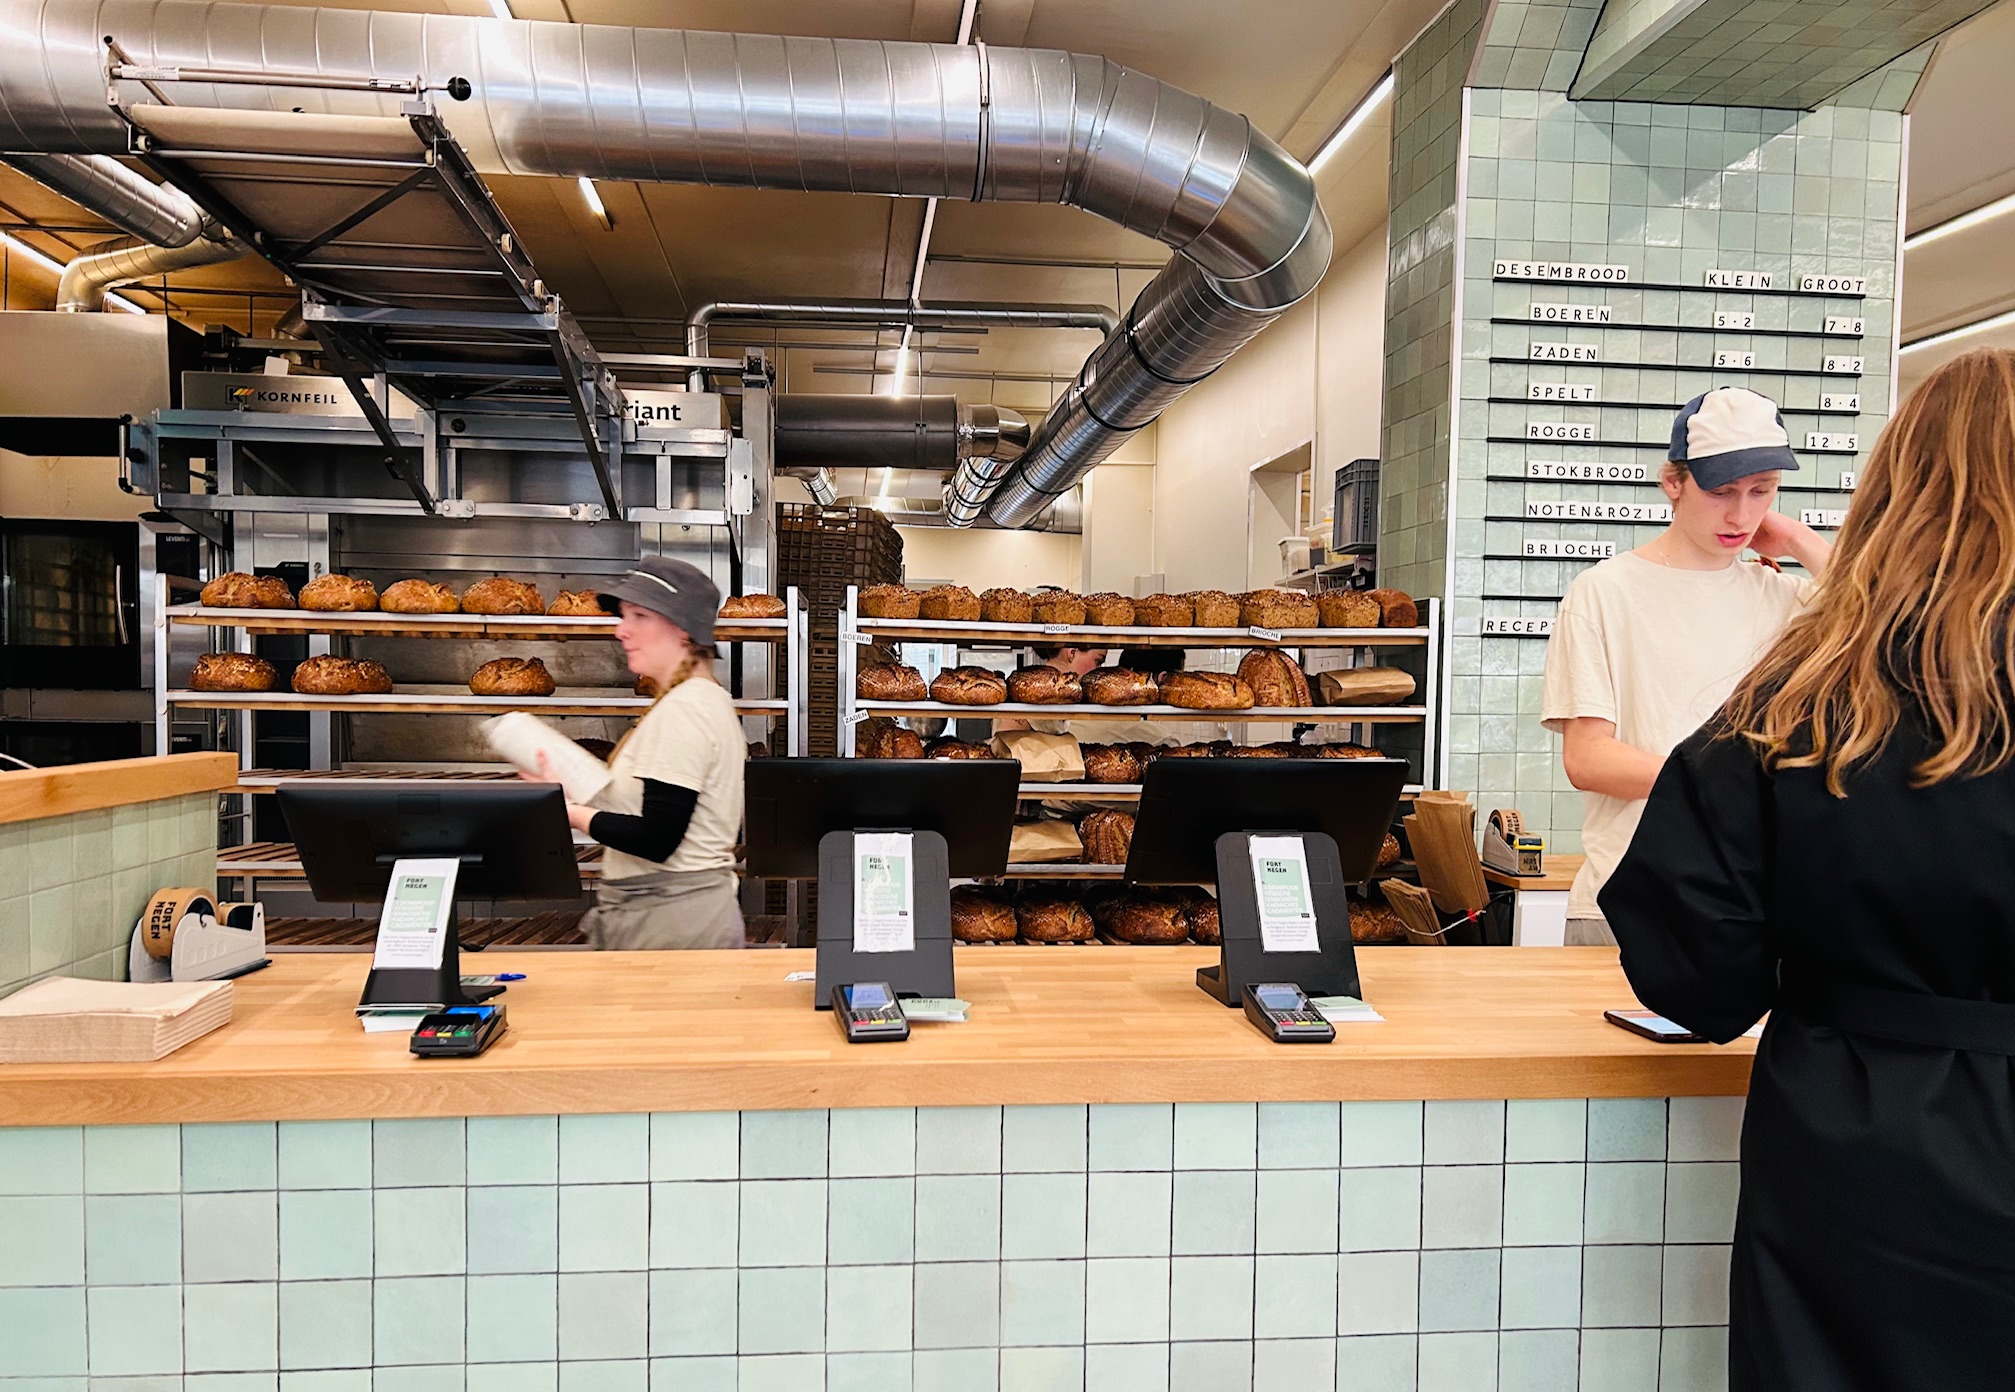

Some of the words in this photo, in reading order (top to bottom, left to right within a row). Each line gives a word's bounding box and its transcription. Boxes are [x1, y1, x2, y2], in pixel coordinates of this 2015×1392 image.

[1496, 263, 1626, 280] DESEMBROOD
[1708, 273, 1771, 288] KLEIN
[1803, 278, 1864, 292] GROOT
[1533, 307, 1609, 322] BOEREN
[1533, 345, 1596, 360] ZADEN
[257, 391, 338, 404] KORNFEIL
[1532, 386, 1593, 399] SPELT
[1530, 425, 1591, 439] ROGGE
[1532, 464, 1645, 480] STOKBROOD
[1844, 476, 1852, 487] 3
[1528, 504, 1675, 520] NOTEN&ROZIJ
[1526, 543, 1613, 557] BRIOCHE
[1486, 620, 1555, 633] RECEP
[842, 633, 871, 643] BOEREN
[845, 711, 867, 723] ZADEN
[150, 901, 167, 940] NEGEN
[161, 901, 177, 932] FORT
